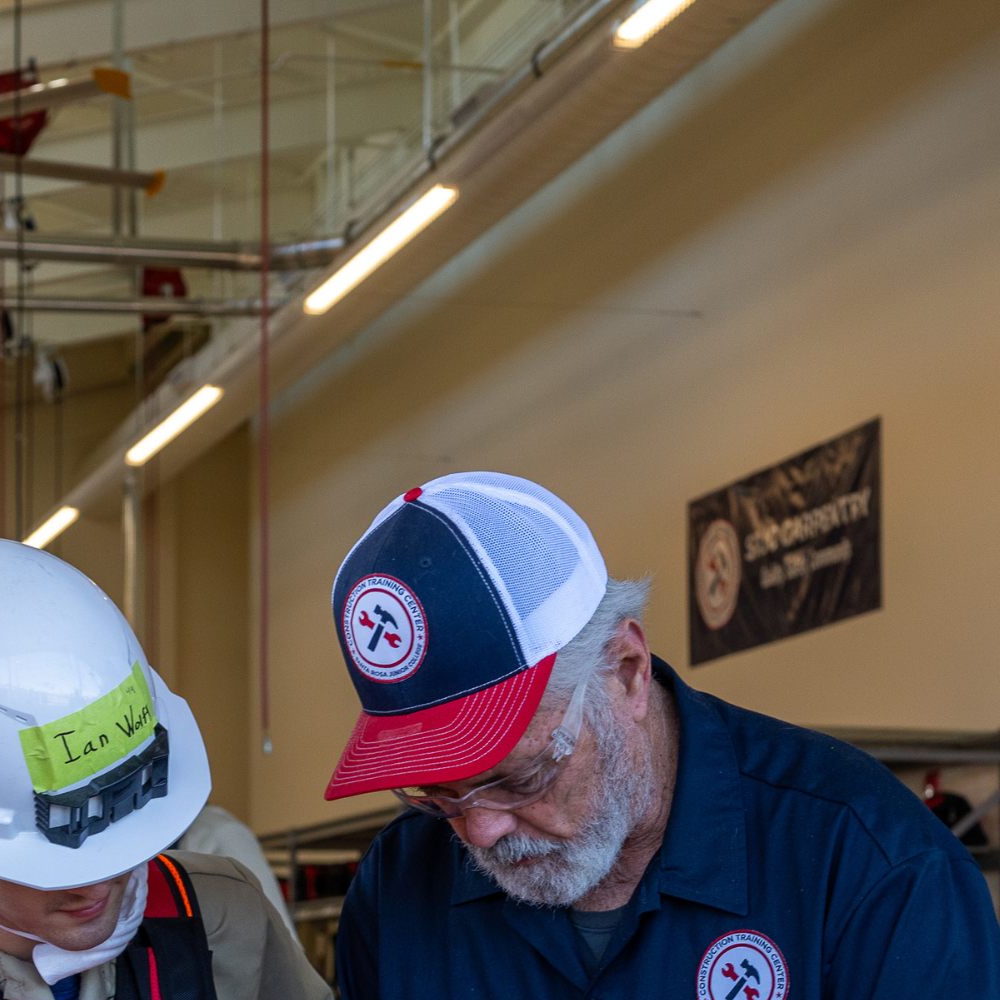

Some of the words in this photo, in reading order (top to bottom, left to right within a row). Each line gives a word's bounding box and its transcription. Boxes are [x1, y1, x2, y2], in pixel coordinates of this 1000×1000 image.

[344, 582, 367, 647] CONSTRUCTION
[368, 578, 405, 596] TRAINING
[403, 595, 424, 632] CENTER
[53, 730, 109, 764] Ian
[699, 936, 734, 996] CONSTRUCTION
[735, 934, 772, 954] TRAINING
[771, 953, 785, 990] CENTER
